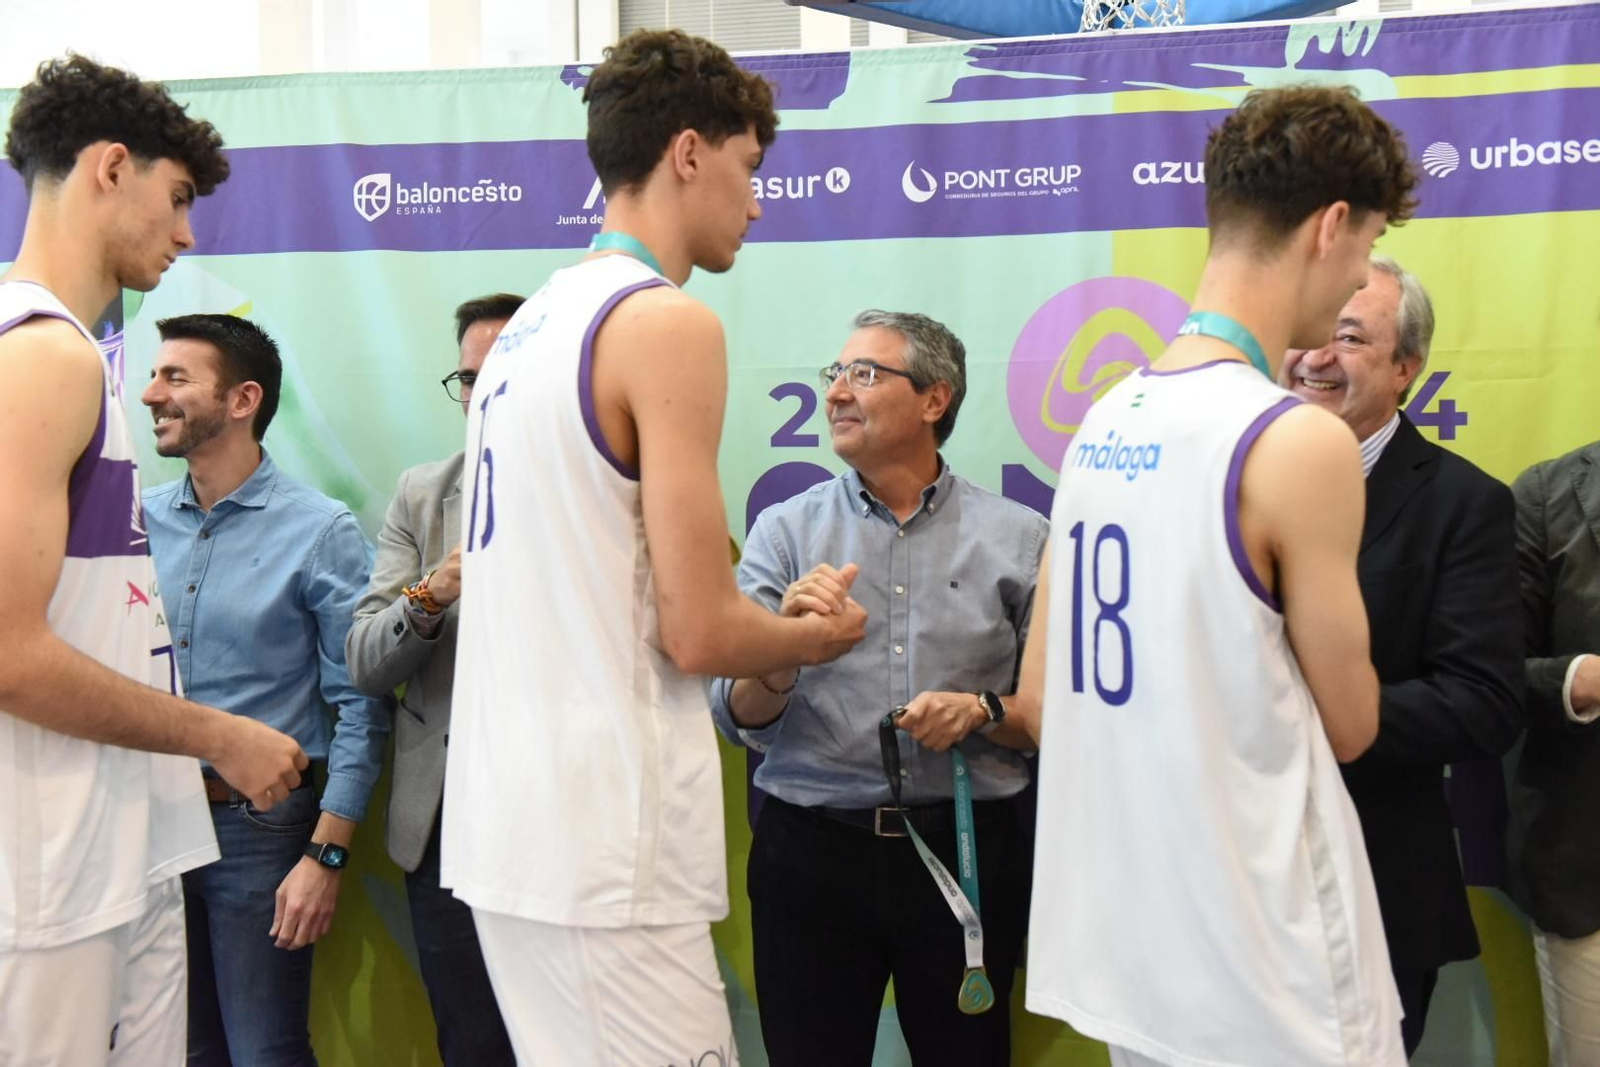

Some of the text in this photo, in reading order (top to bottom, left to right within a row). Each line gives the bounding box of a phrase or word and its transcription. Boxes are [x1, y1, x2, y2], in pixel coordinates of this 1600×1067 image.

[945, 165, 1081, 190] PONT GRUP
[396, 205, 441, 215] ESPAÑA
[556, 215, 587, 225] Junta
[1072, 430, 1162, 481] málaga
[1069, 520, 1134, 706] 18
